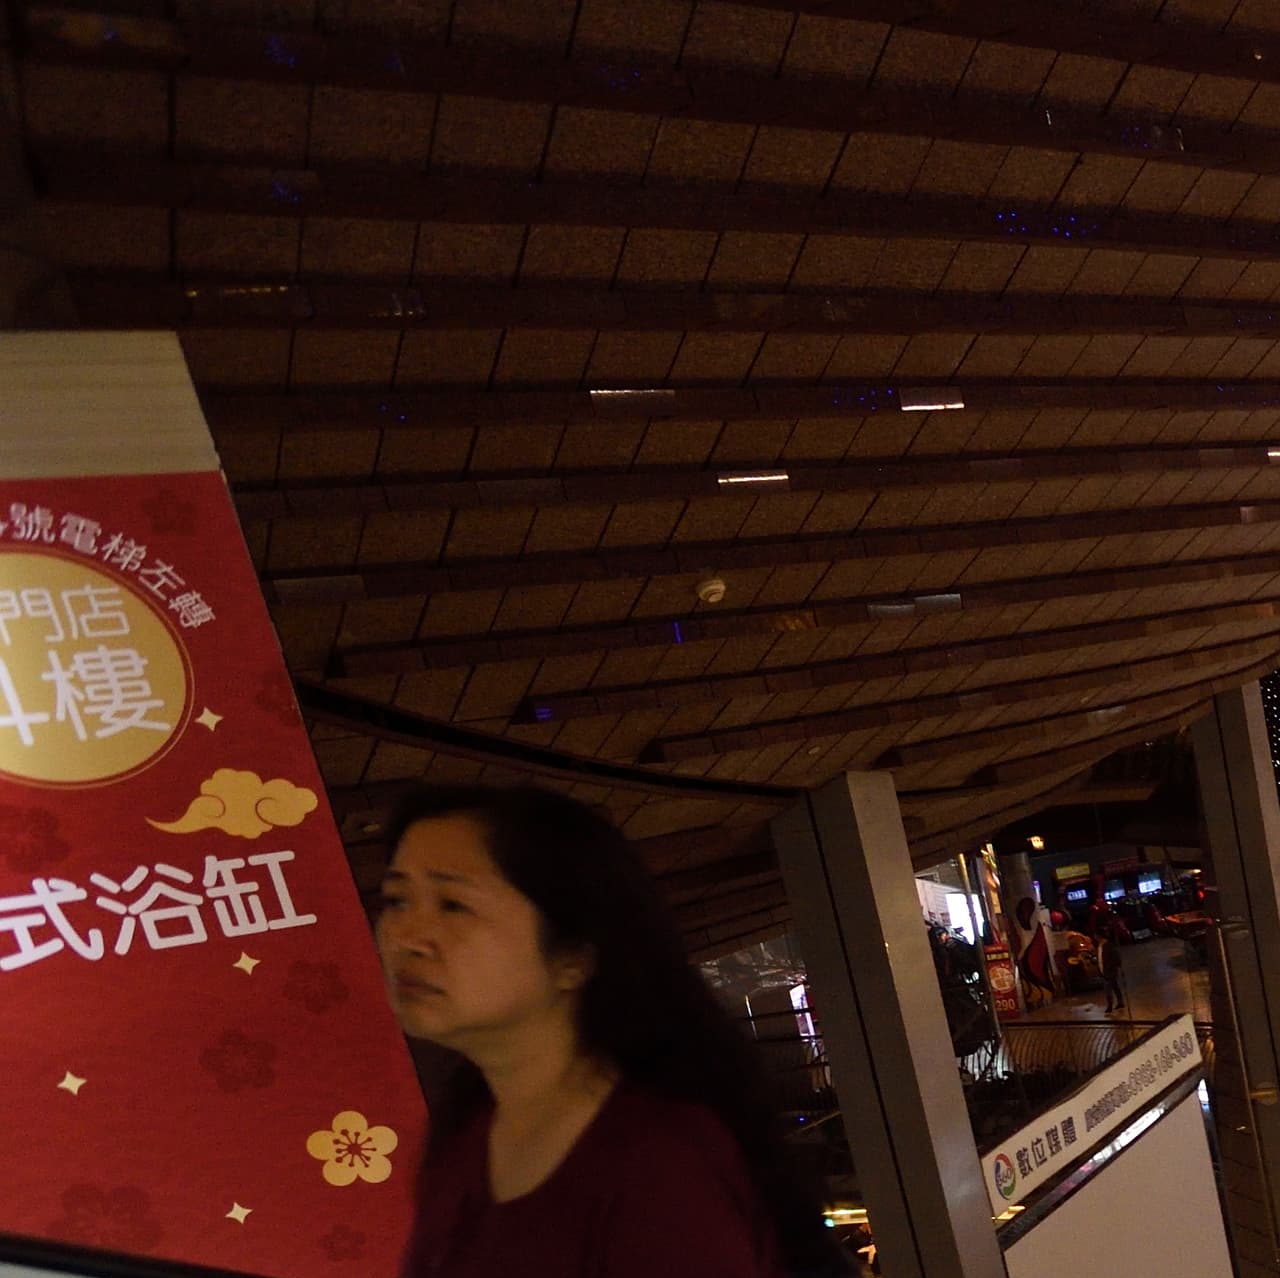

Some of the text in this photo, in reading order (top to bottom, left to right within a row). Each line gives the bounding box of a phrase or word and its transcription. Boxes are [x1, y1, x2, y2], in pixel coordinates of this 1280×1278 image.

[0, 503, 216, 632] 號電梯左轉
[0, 849, 319, 971] 式浴缸
[1015, 1116, 1077, 1180] 數位媒體
